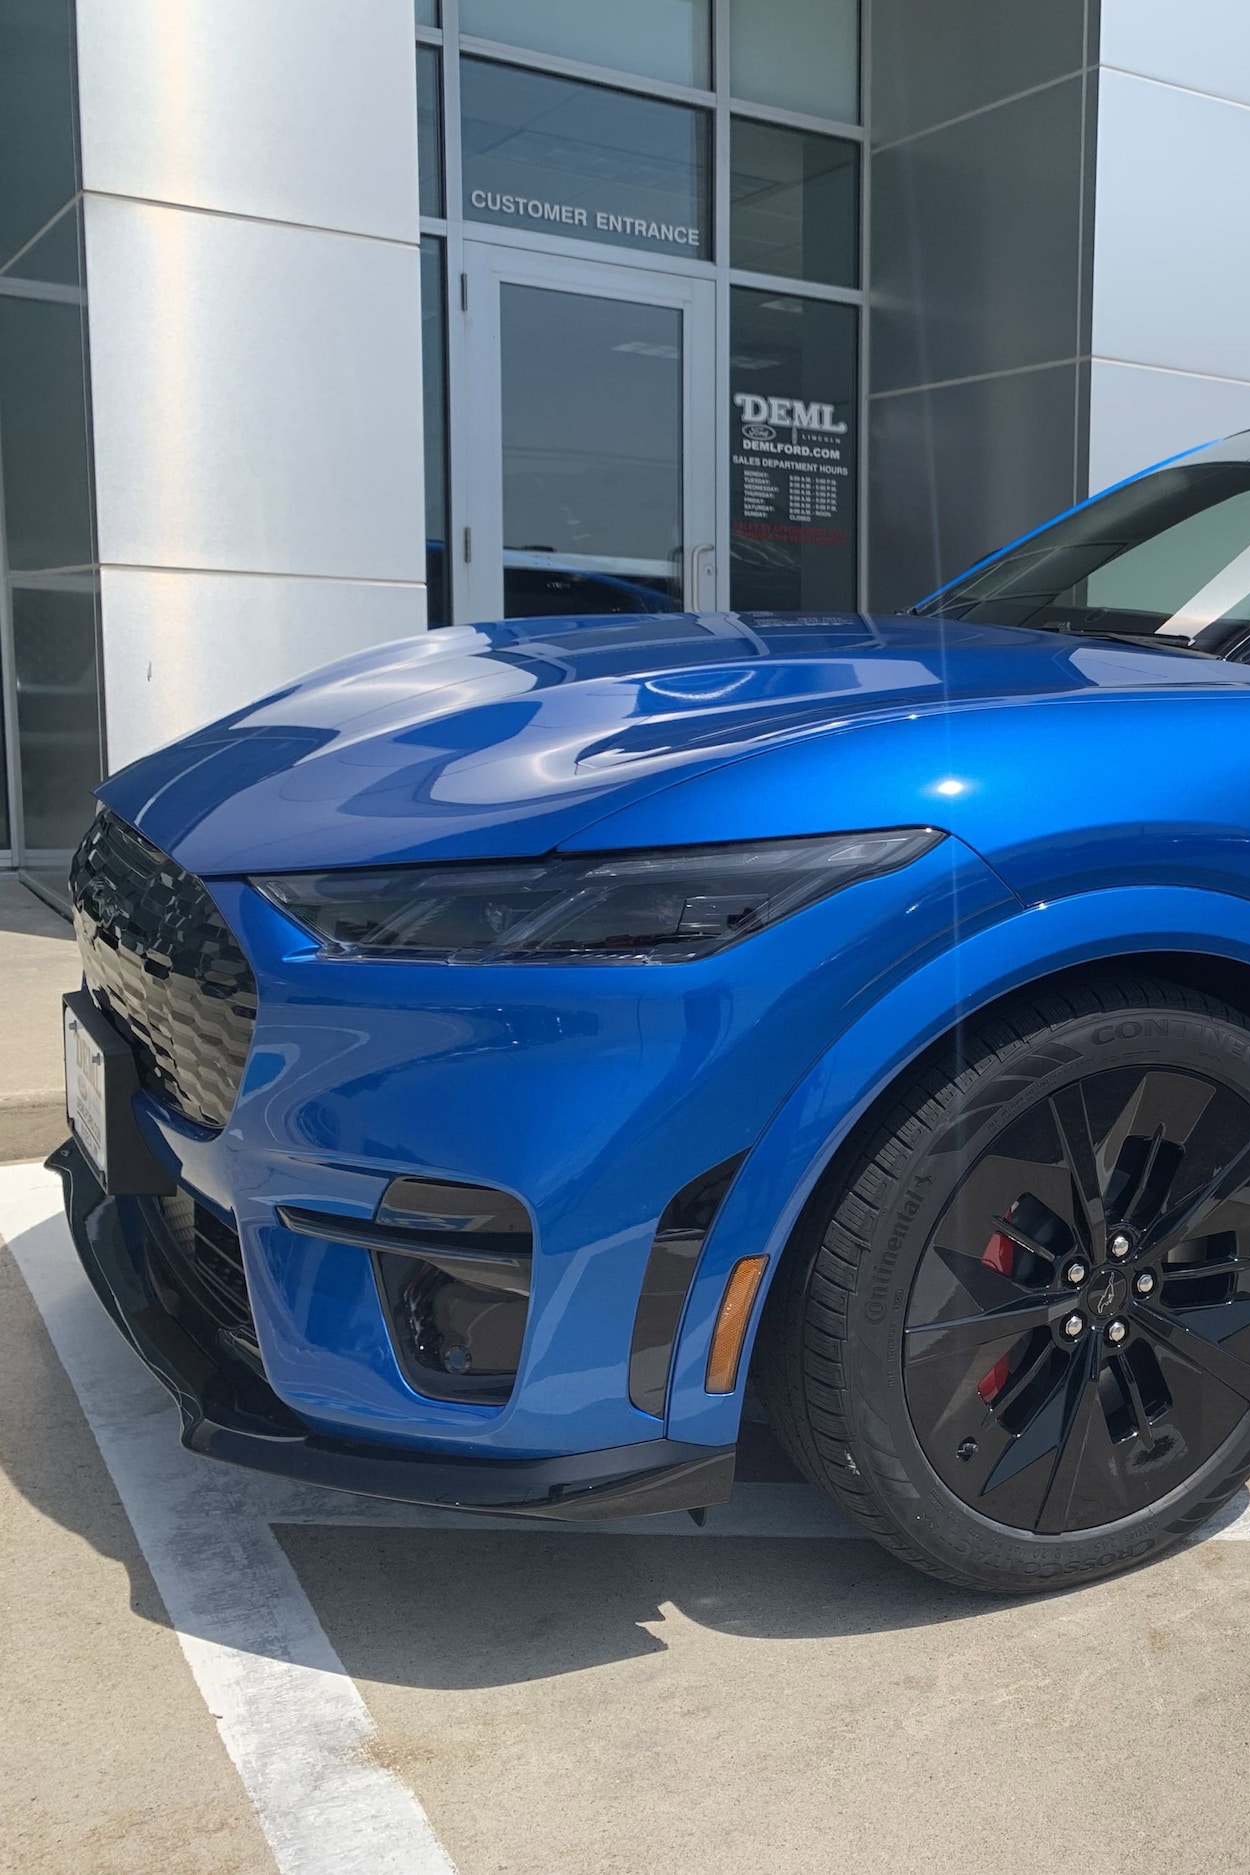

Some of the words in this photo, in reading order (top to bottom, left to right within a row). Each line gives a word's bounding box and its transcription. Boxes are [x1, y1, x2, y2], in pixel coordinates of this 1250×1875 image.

[471, 190, 587, 226] CUSTOMER
[596, 212, 699, 246] ENTRANCE
[733, 393, 848, 434] DEML
[743, 439, 840, 460] DEMLFORD.COM
[802, 433, 840, 444] LINCOLN
[732, 454, 760, 466] SALES
[762, 458, 817, 472] DEPARTMENT
[819, 464, 848, 476] HOURS
[864, 1189, 925, 1325] Continental
